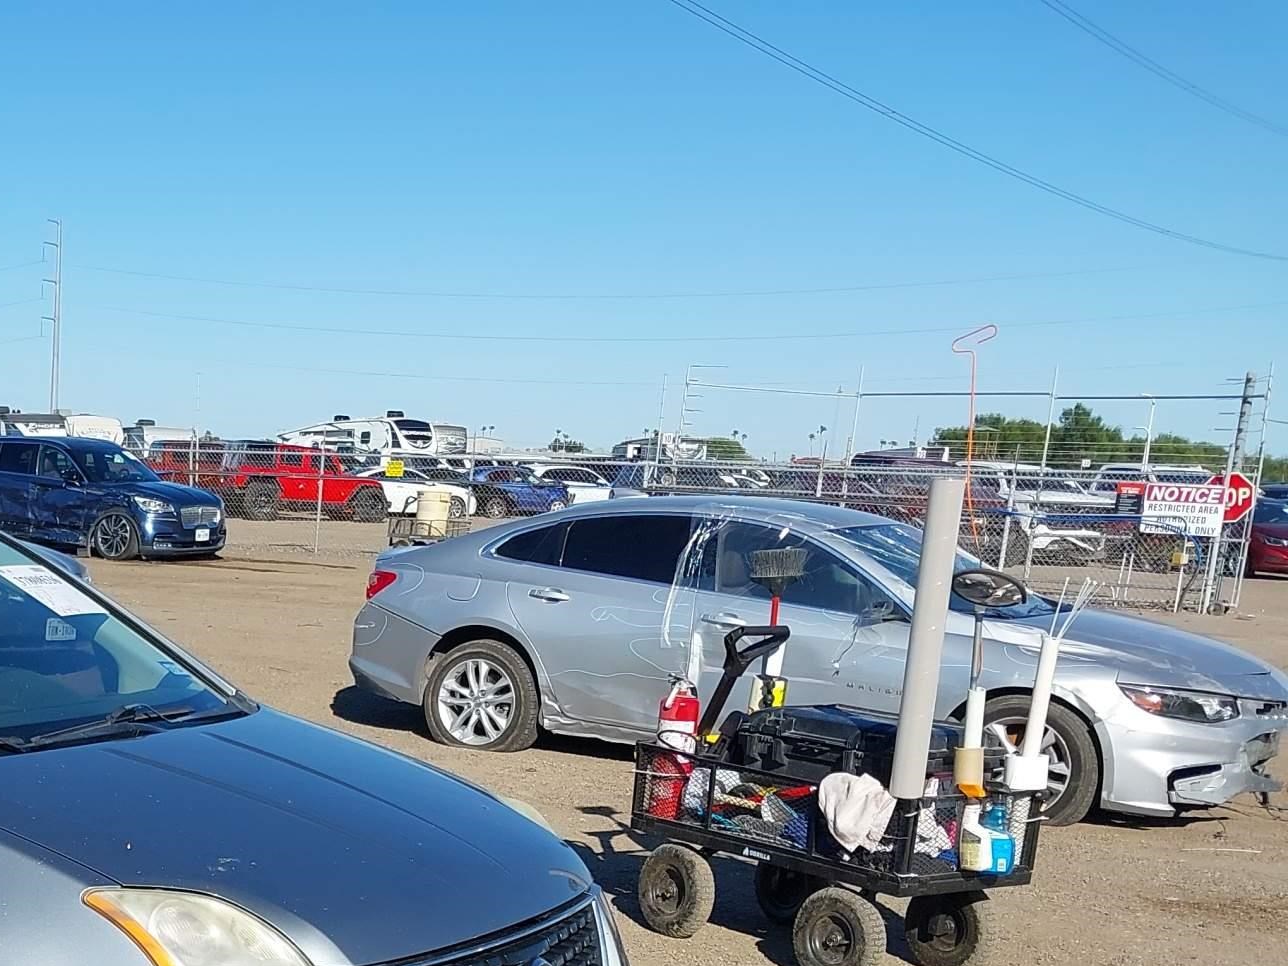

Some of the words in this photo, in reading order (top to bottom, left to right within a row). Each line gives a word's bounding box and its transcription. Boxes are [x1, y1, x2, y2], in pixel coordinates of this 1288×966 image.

[1149, 486, 1223, 504] NOTICE
[1147, 503, 1196, 514] RESTRICTED
[1198, 505, 1219, 514] AREA
[1194, 526, 1217, 535] ONLY
[749, 849, 771, 861] GORILLA
